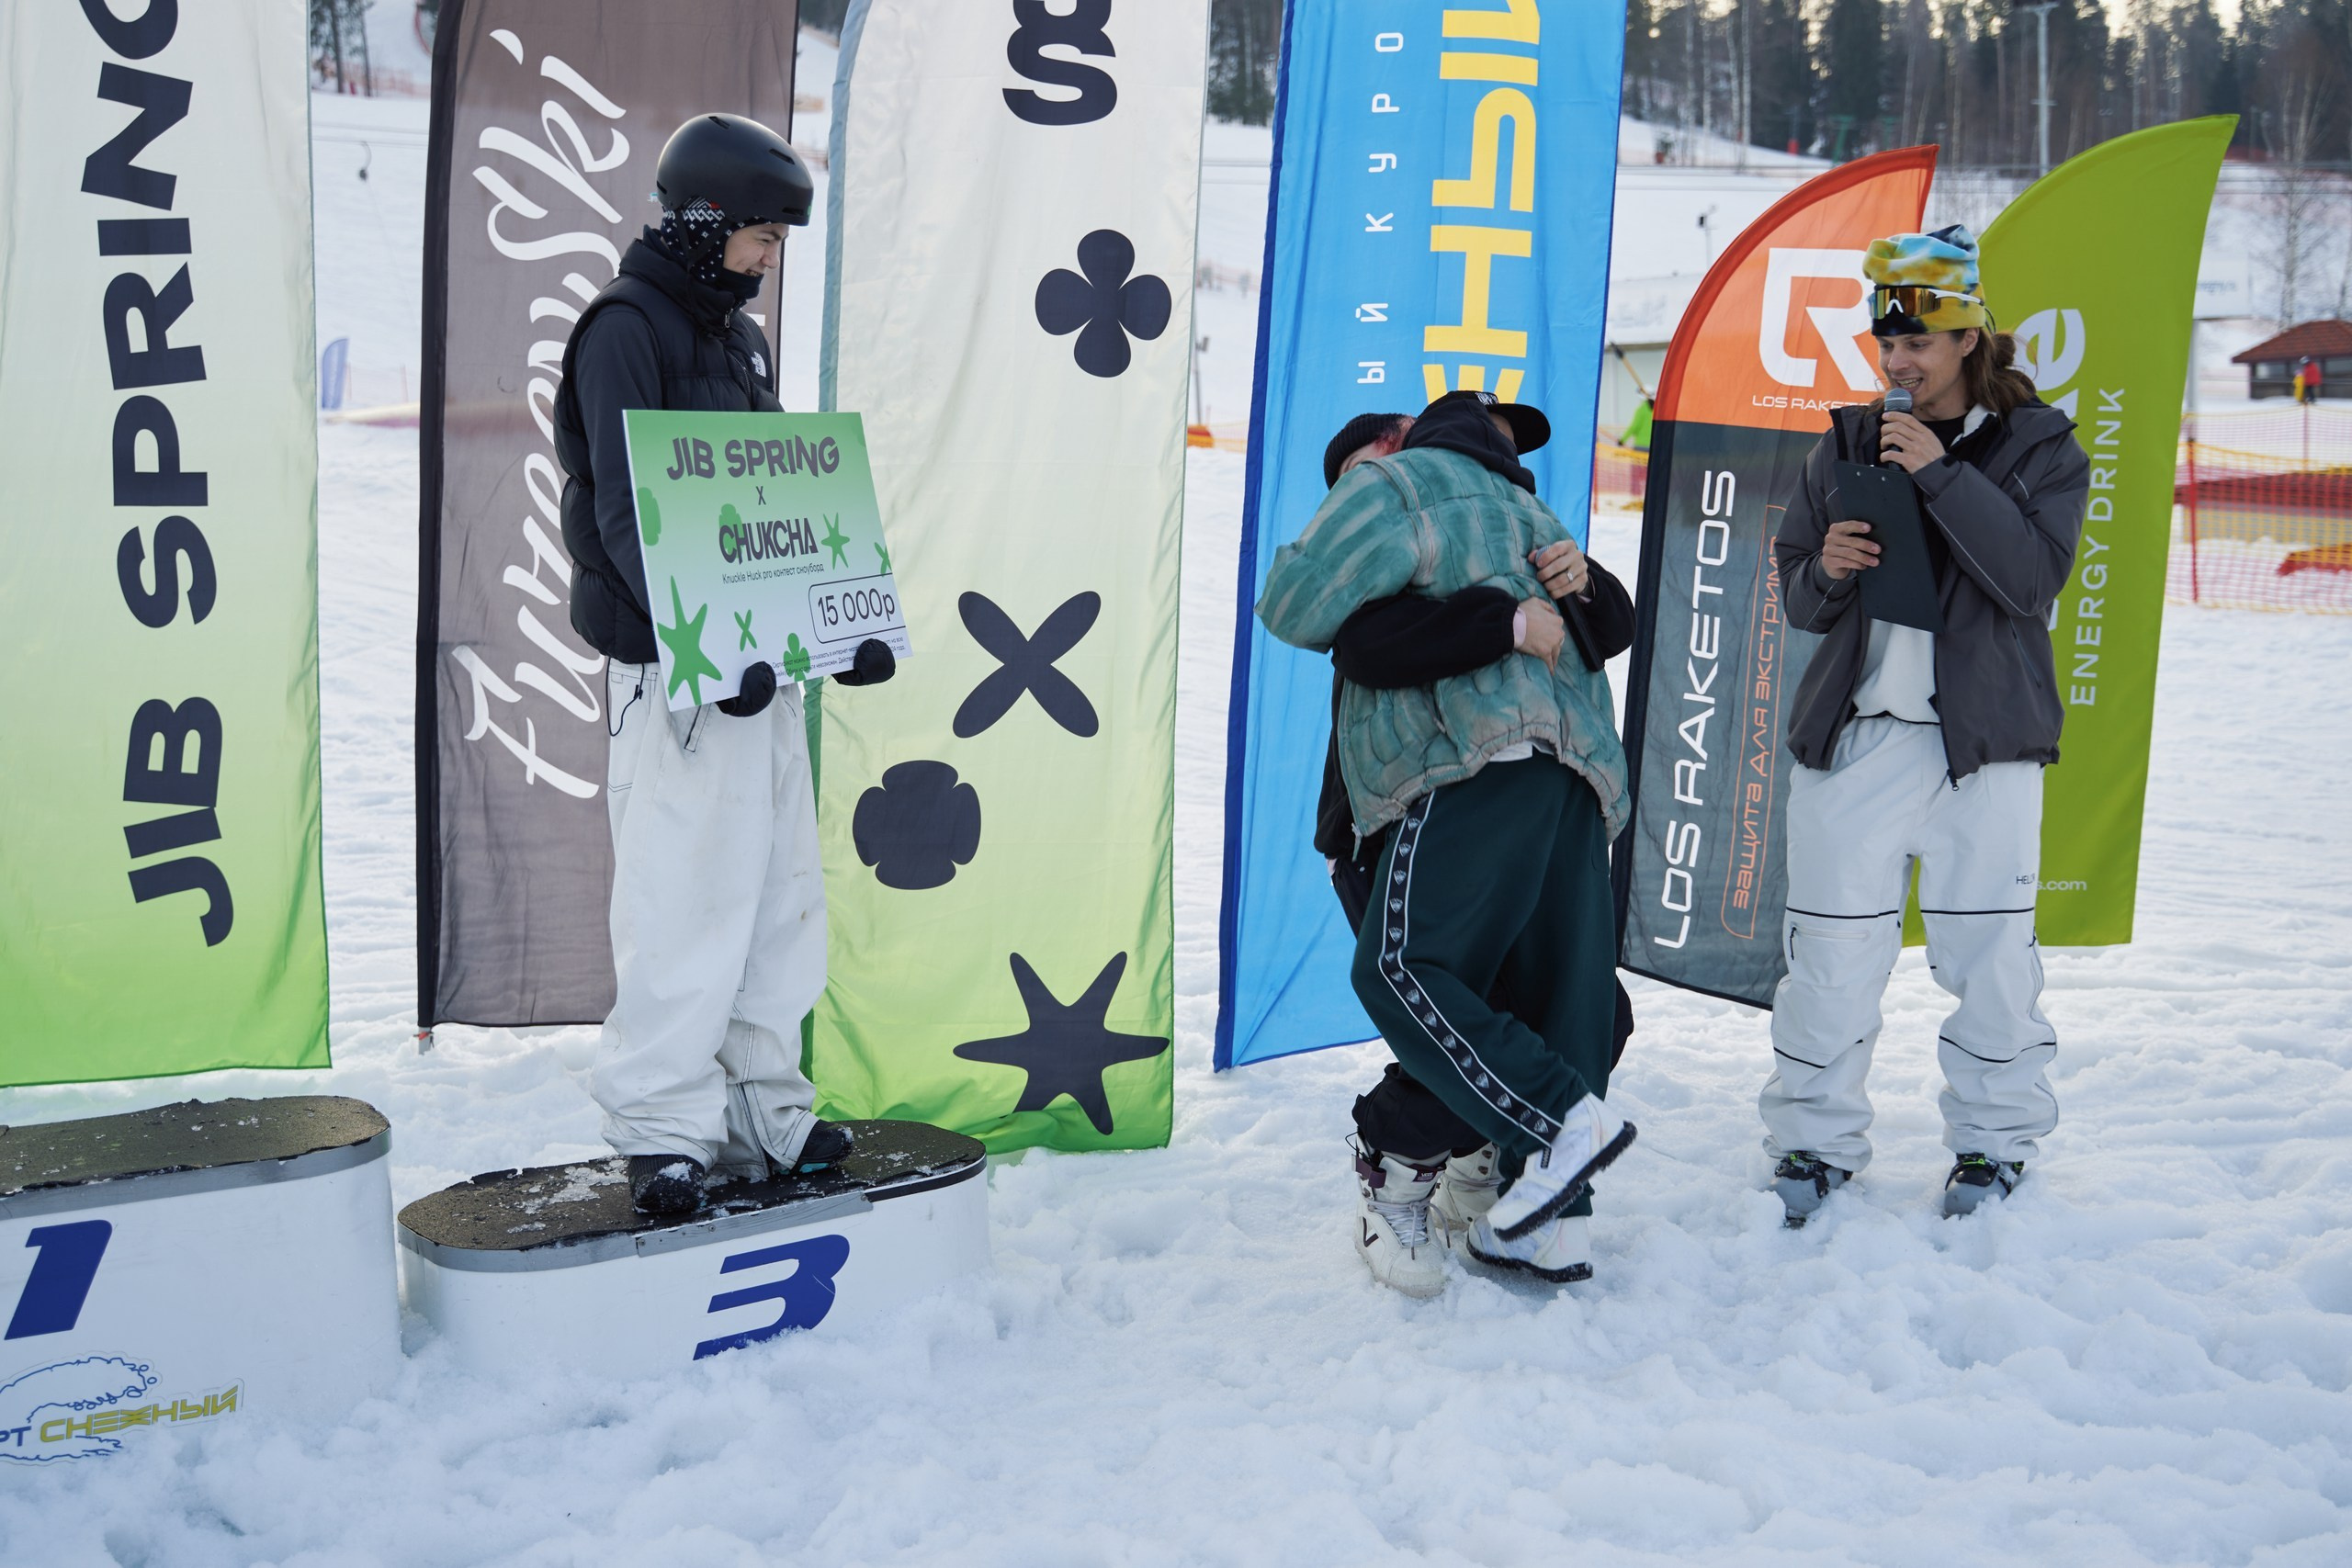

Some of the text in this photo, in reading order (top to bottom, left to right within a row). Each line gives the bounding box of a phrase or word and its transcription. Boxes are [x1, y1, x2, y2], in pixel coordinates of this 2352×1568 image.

[1752, 395, 1871, 412] LOS RAKE
[666, 434, 840, 480] JIB SPRING
[718, 517, 819, 565] CHUKCHA
[722, 572, 745, 584] Knuckle
[2070, 389, 2124, 705] ENERGY DRINK
[818, 595, 838, 626] 15
[1654, 470, 1736, 949] LOS RAKETOS
[123, 695, 234, 947] JIB
[4, 1220, 113, 1340] 1
[693, 1234, 850, 1361] 3
